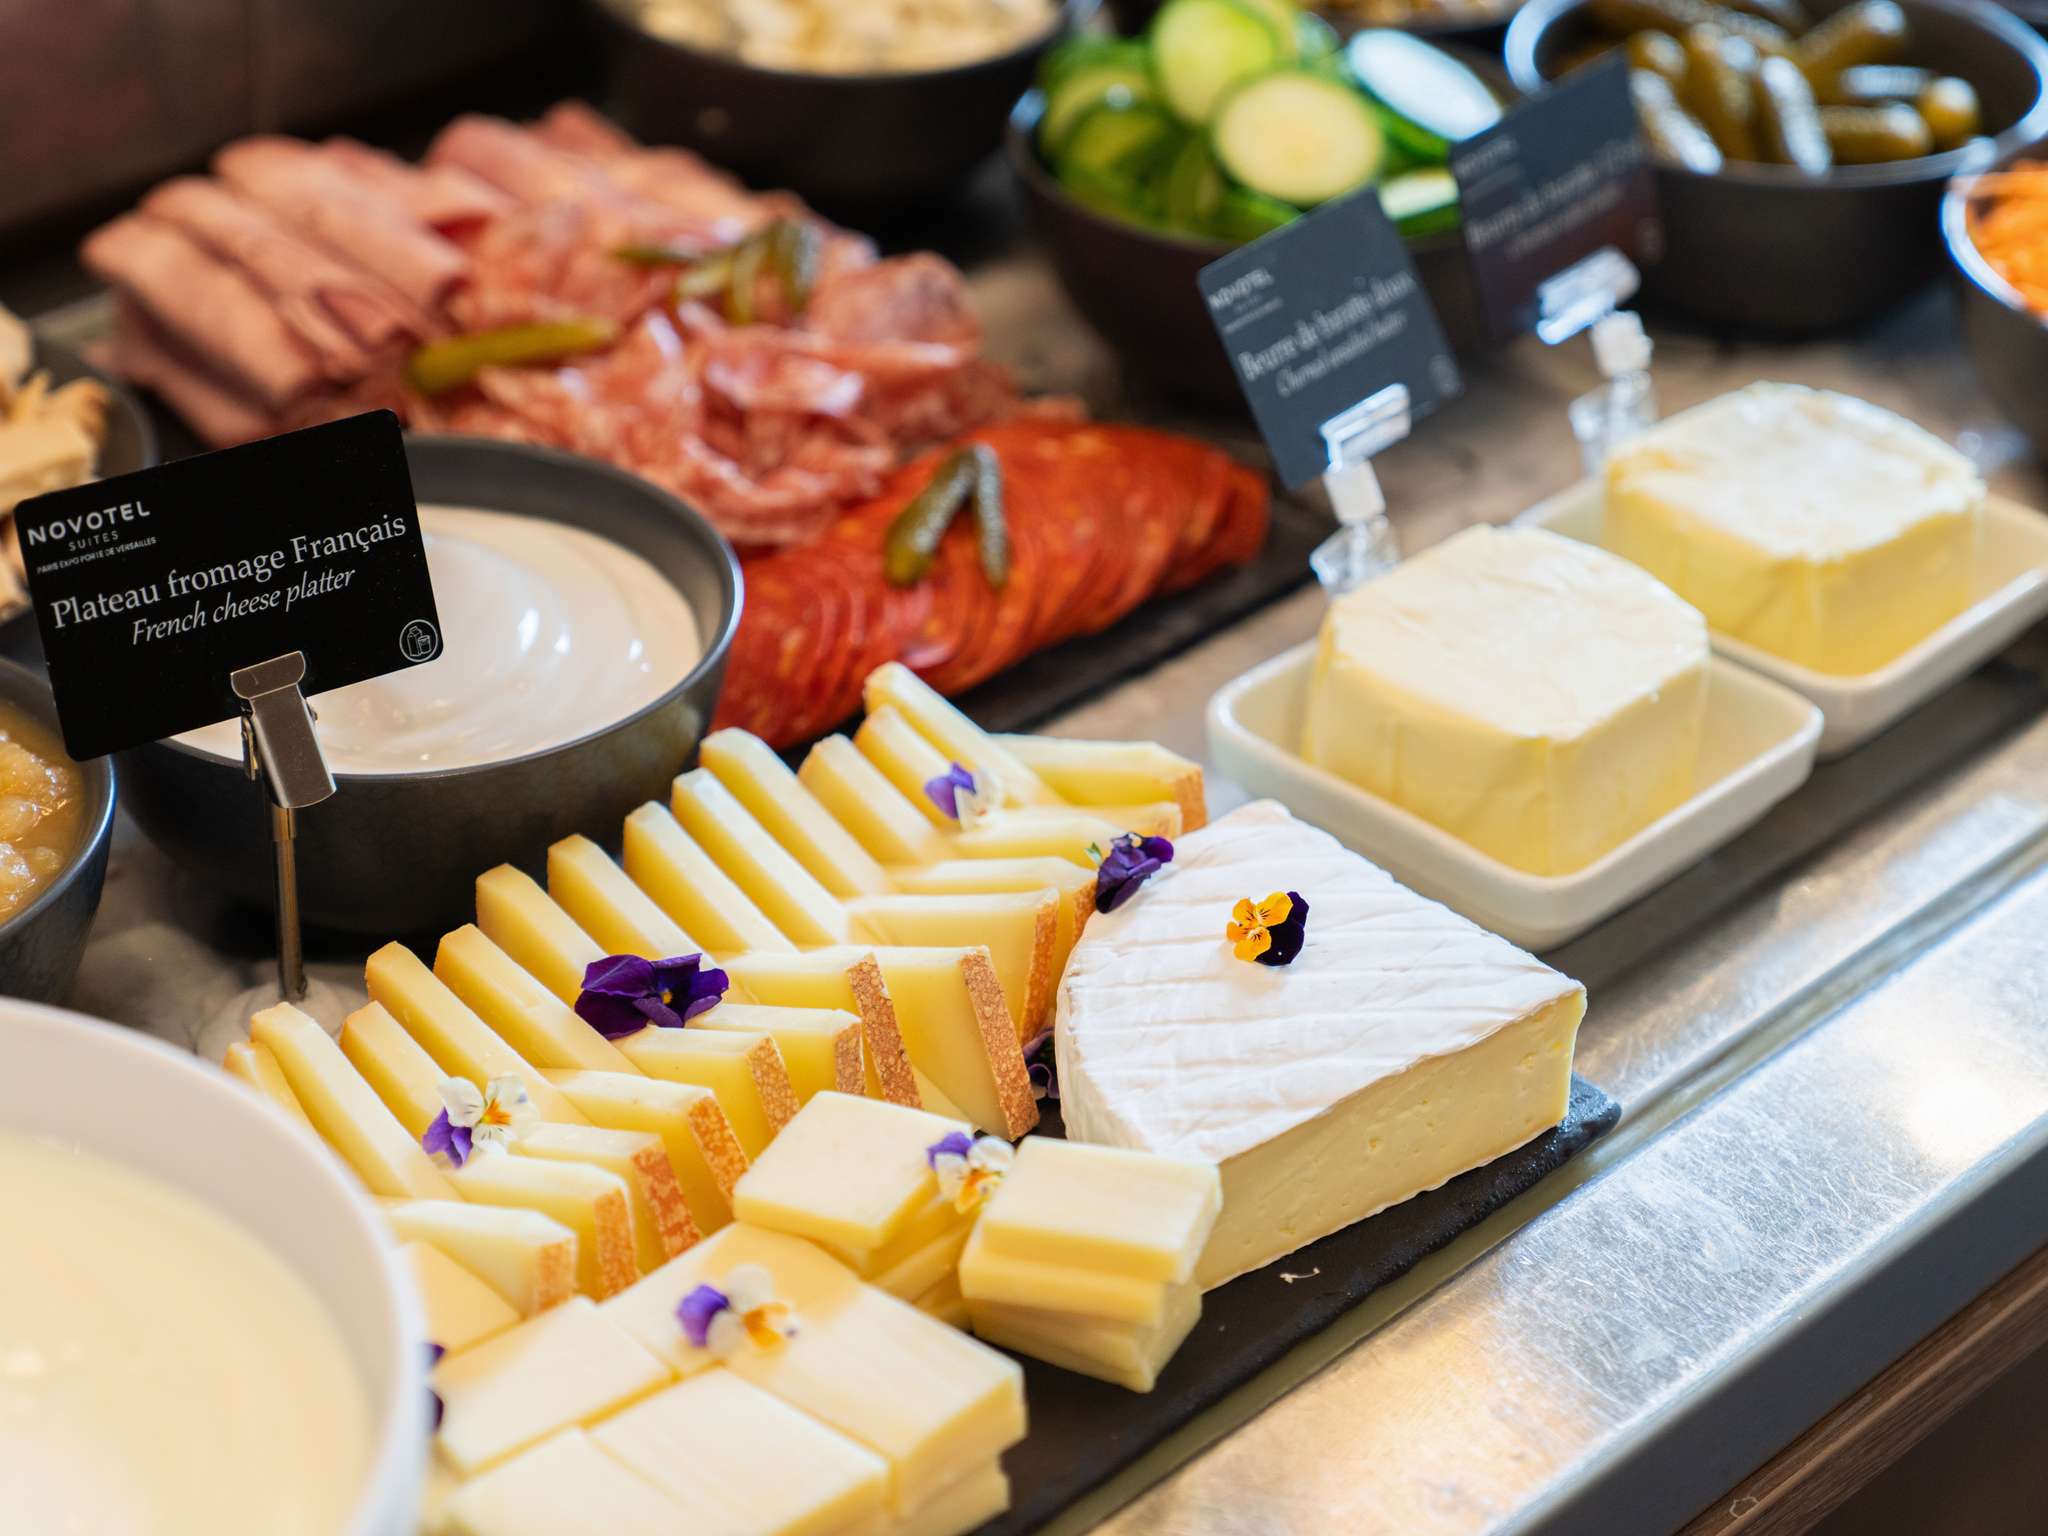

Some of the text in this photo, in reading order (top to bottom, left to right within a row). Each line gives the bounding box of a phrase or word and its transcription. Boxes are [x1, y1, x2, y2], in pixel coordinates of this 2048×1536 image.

[27, 501, 150, 546] NOVOTEL
[68, 530, 119, 552] SUITES
[36, 537, 157, 575] PARIS EXPO PORTE DE VERSAILLES
[51, 513, 407, 629] Plateau fromage Français
[131, 567, 356, 645] French cheese platter
